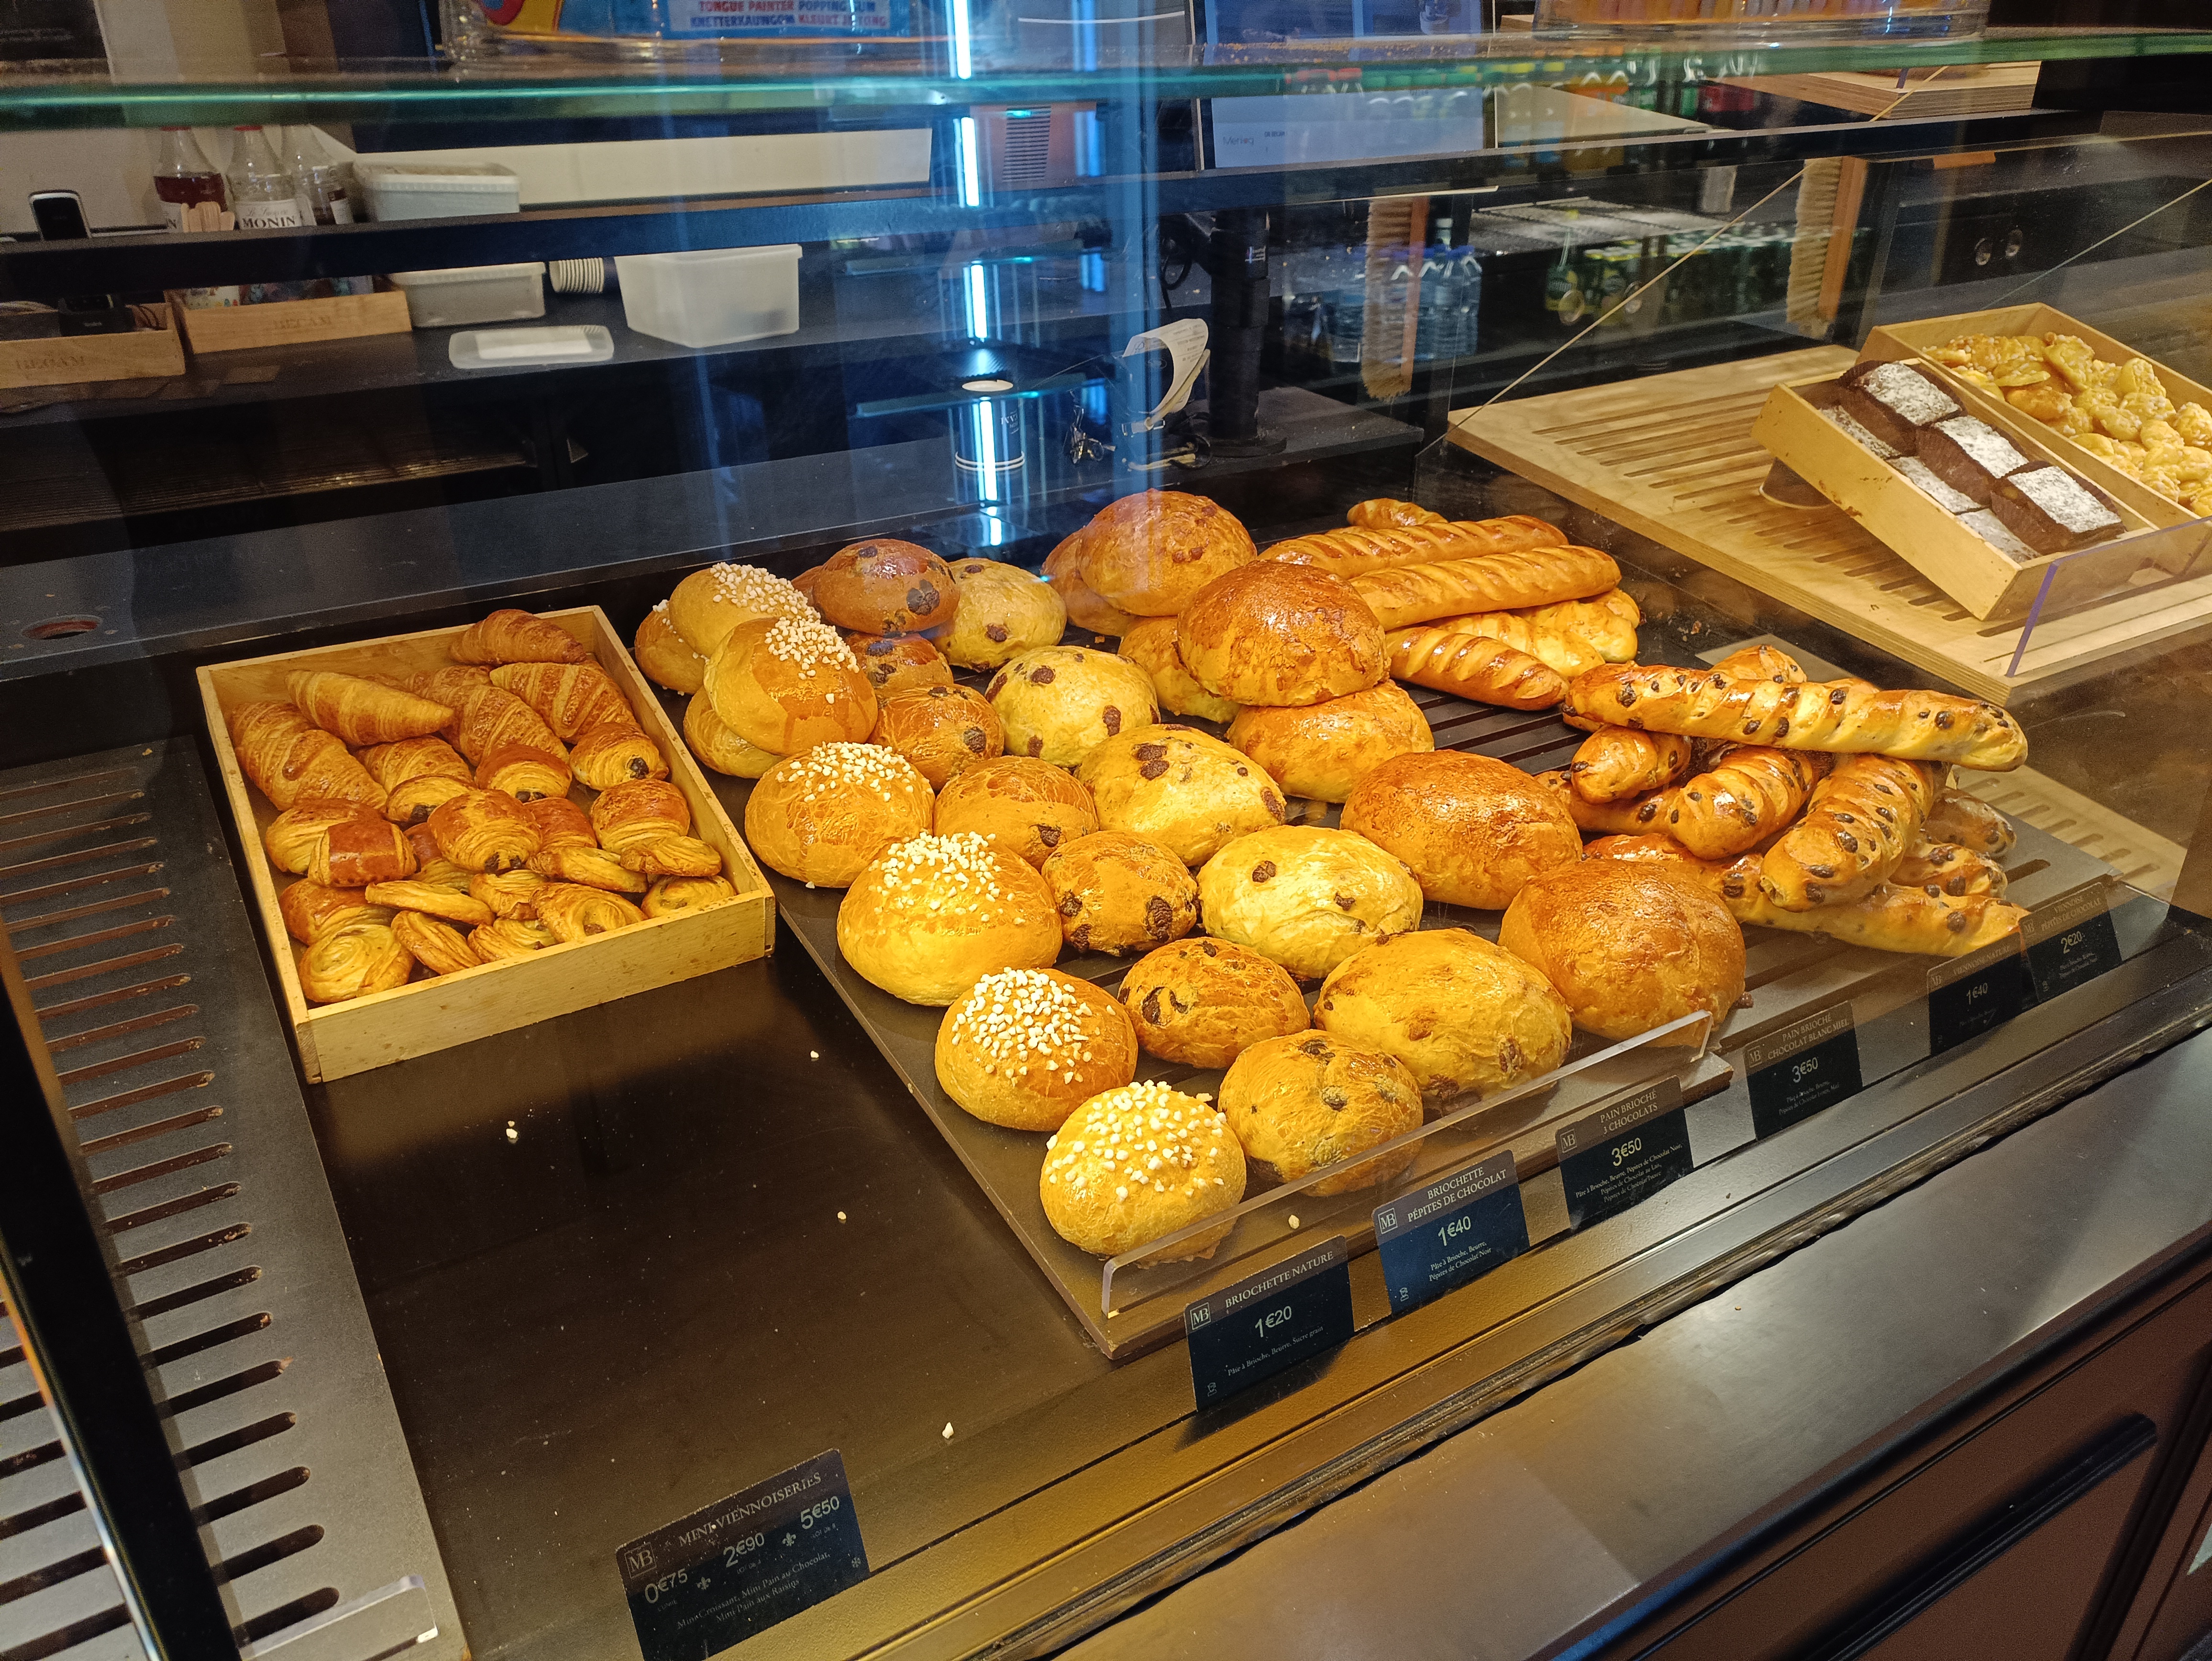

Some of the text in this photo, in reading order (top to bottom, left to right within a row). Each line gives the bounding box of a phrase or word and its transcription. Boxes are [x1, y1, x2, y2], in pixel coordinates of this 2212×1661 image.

[243, 216, 296, 228] MONIN
[2061, 930, 2082, 954] 2€20
[1768, 1018, 1849, 1060] CHOCOLAT BLANC MIEL
[1782, 1012, 1832, 1041] PAIN BRIOCHÉ
[1792, 1057, 1818, 1083] 3€50
[1600, 1088, 1657, 1123] PAIN BRIOCHÉ
[1604, 1102, 1658, 1135] 3 CHOCOLATS
[1611, 1137, 1642, 1166] 3€50
[1407, 1169, 1506, 1222] PÉPITES DE CHOCOLAT
[1427, 1166, 1484, 1199] BRIOCHETTE
[1438, 1216, 1471, 1246] 1€40
[1429, 1270, 1448, 1282] Pépites
[1455, 1254, 1479, 1268] Chocolat
[1479, 1247, 1492, 1257] Noir
[1447, 1250, 1468, 1263] Brioche,
[1225, 1251, 1334, 1308] BRIOCHETTE NATURE
[1255, 1306, 1292, 1338] 1€20
[1246, 1353, 1270, 1368] Brioche,
[1293, 1333, 1308, 1344] Sucre
[1309, 1325, 1323, 1338] grain
[679, 1472, 821, 1547] MINI VIENNOISERIES
[645, 1496, 840, 1604] 0€75 2€90 5€50
[698, 1596, 741, 1618] Croissant,
[741, 1585, 761, 1599] Mini
[762, 1575, 780, 1588] Pain
[792, 1551, 831, 1573] Chocolat,
[716, 1578, 800, 1623] Mini Pain aux Raisins
